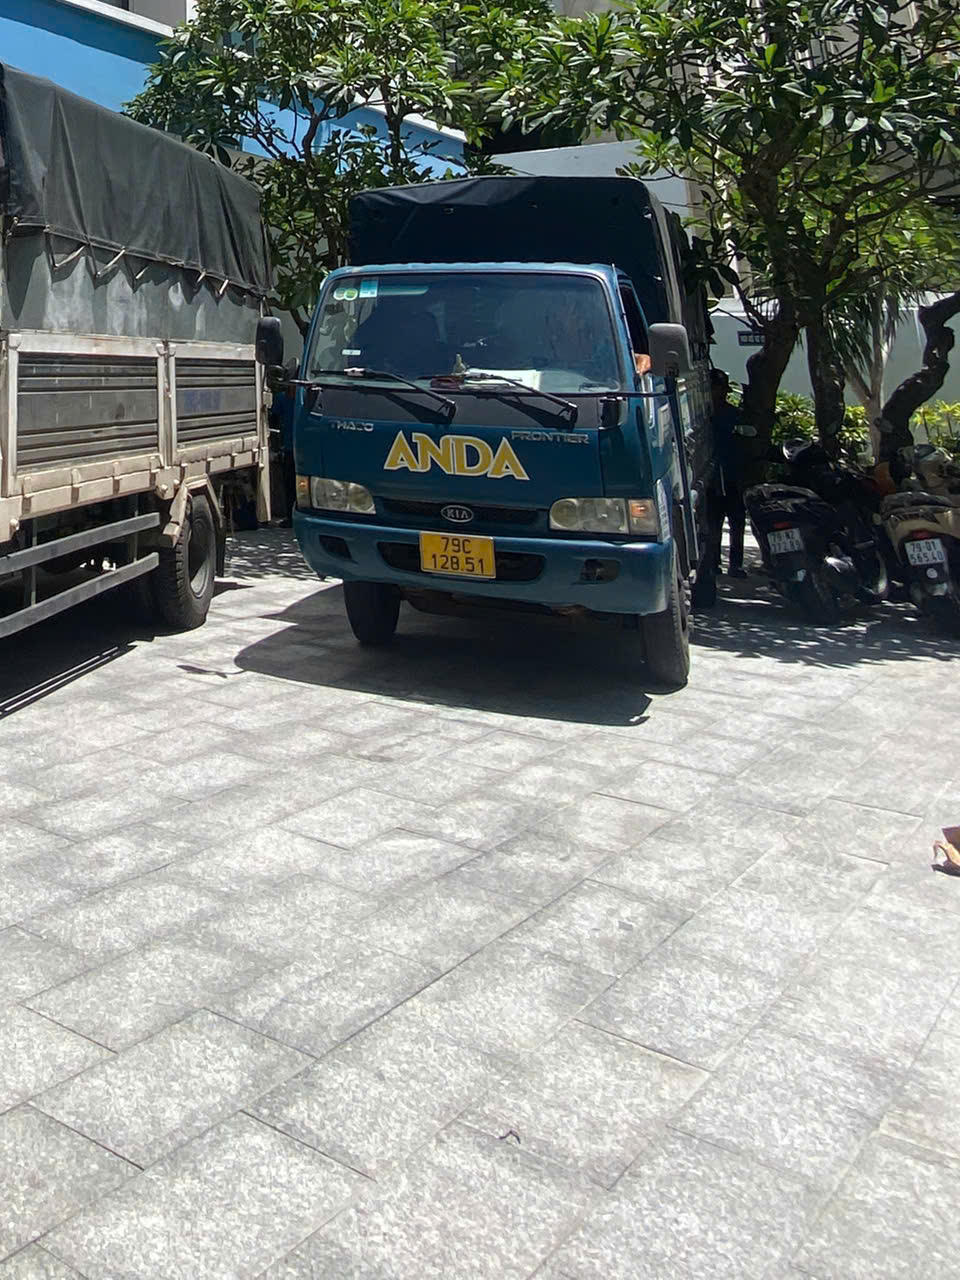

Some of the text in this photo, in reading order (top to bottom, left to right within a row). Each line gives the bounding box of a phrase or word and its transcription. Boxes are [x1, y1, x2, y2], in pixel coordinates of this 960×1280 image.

[511, 430, 591, 445] FRONTIER
[383, 430, 530, 481] ANDA
[446, 508, 469, 519] KIA
[441, 536, 471, 554] 79C
[431, 553, 484, 574] 128.51
